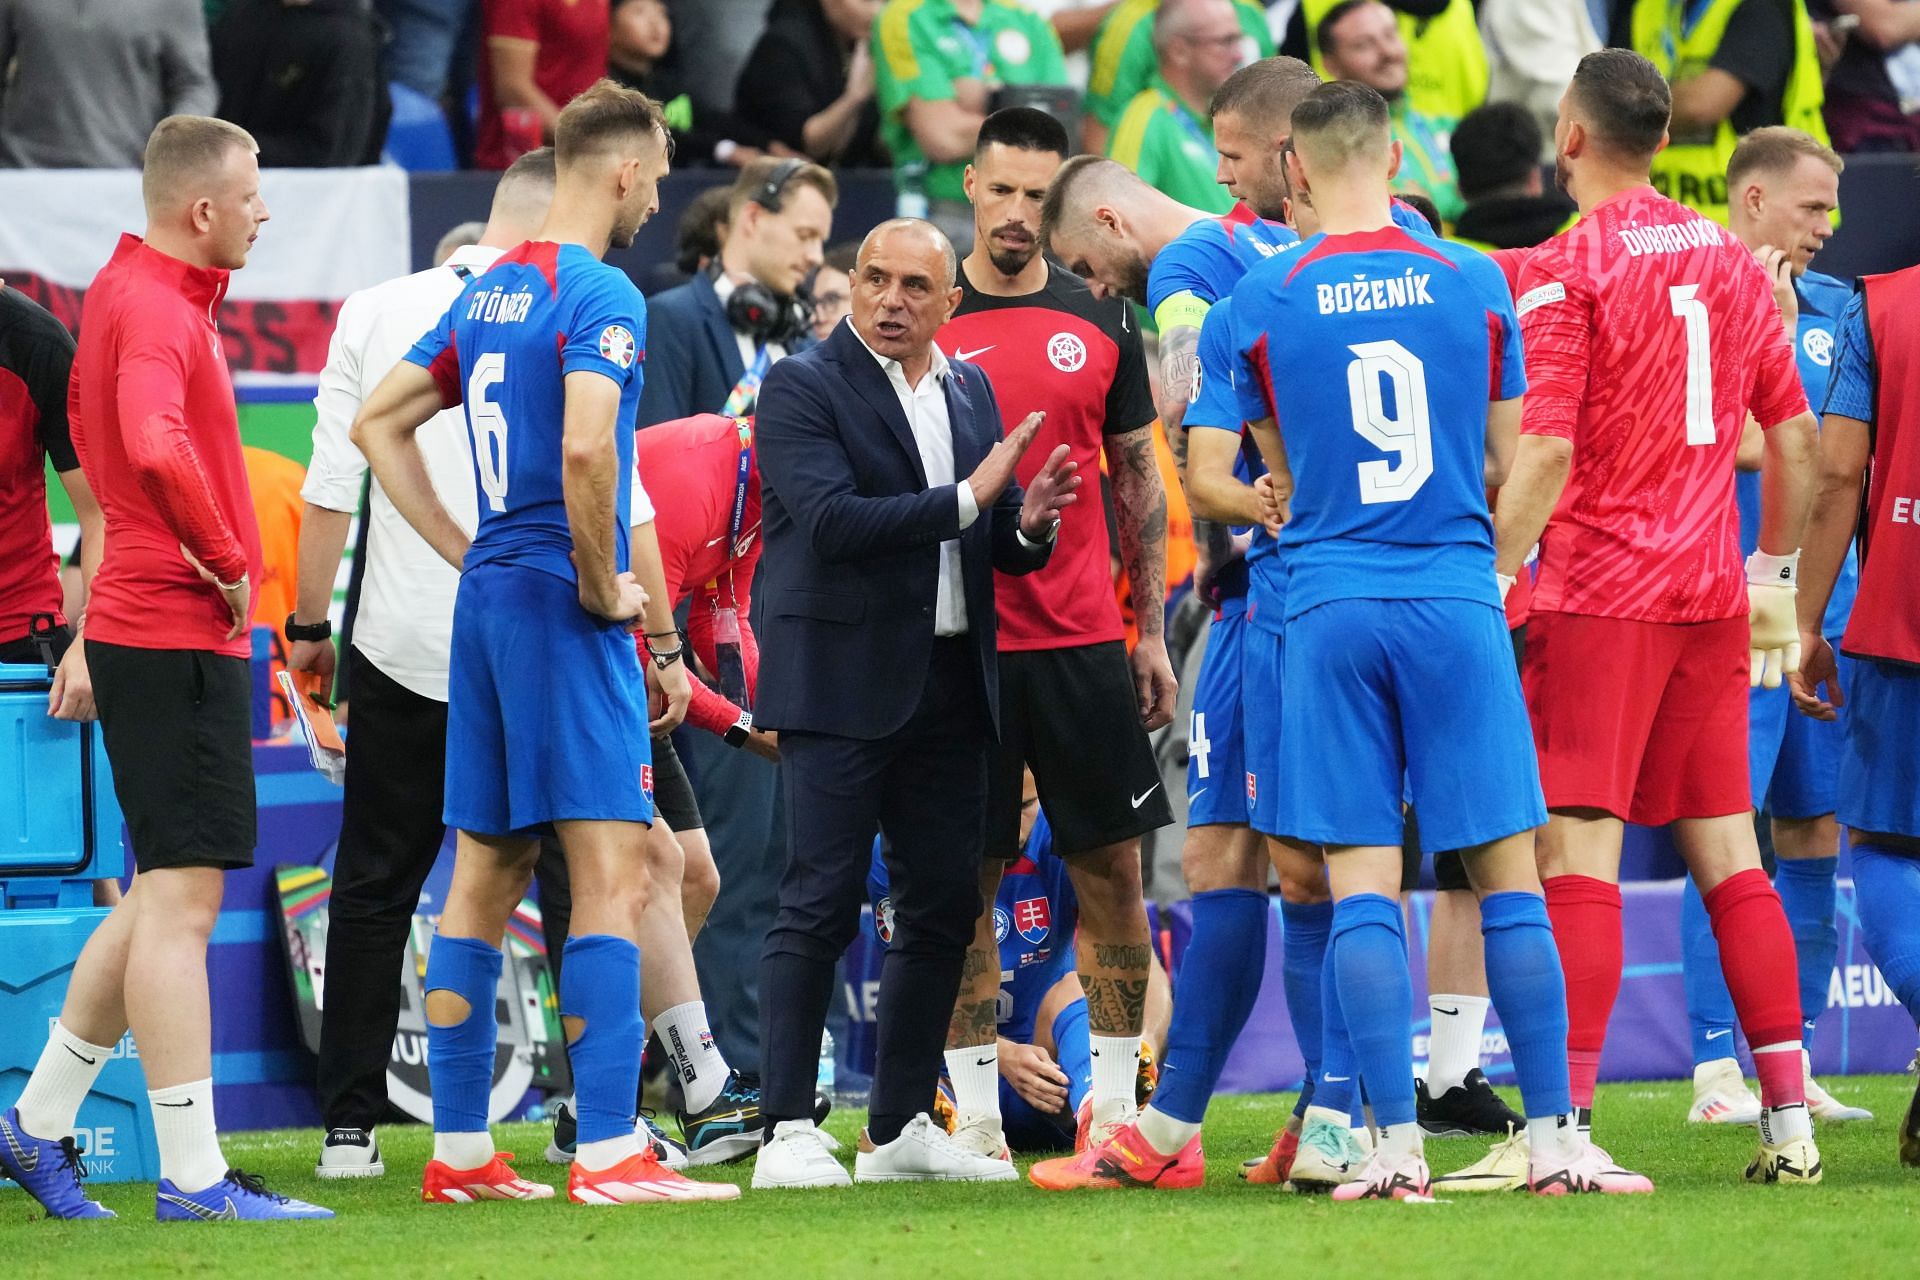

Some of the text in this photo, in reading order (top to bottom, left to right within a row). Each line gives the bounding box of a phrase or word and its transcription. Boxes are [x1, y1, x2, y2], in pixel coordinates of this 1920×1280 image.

[1316, 267, 1435, 315] BOŽENÍK
[1669, 284, 1717, 446] 1
[468, 352, 508, 513] 6
[1347, 339, 1434, 505] 9
[334, 1133, 361, 1141] PRADA
